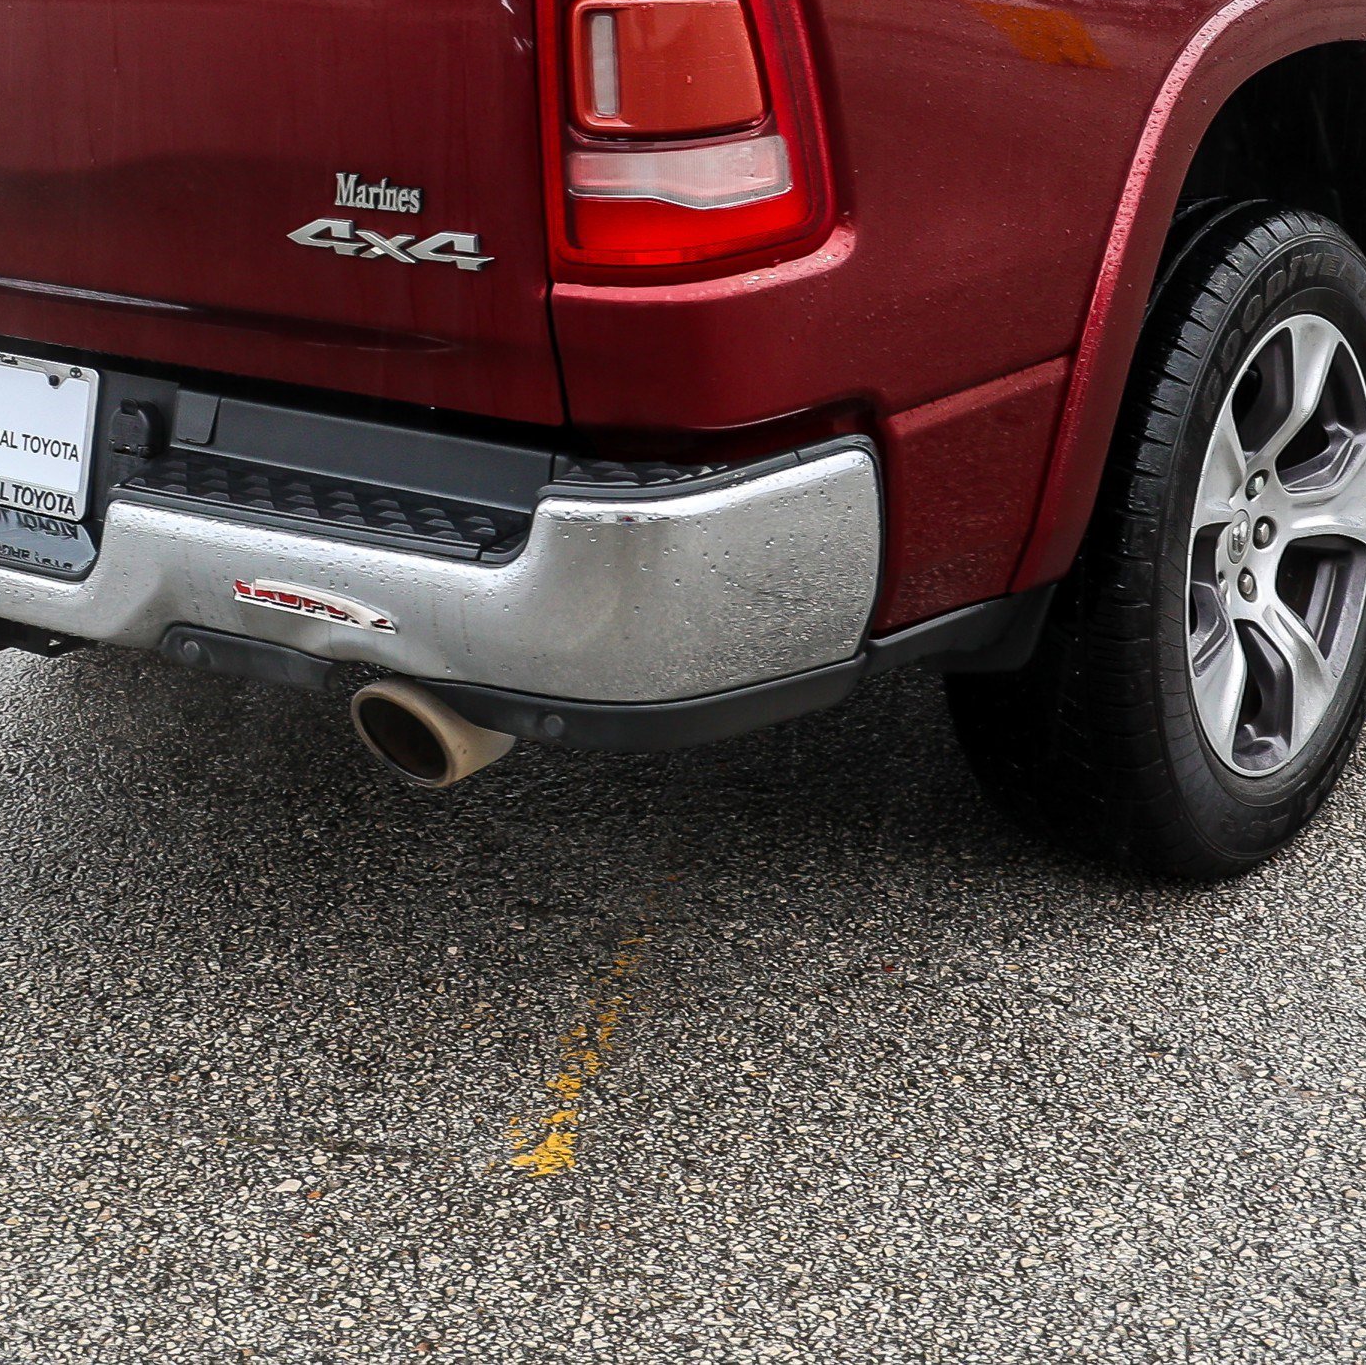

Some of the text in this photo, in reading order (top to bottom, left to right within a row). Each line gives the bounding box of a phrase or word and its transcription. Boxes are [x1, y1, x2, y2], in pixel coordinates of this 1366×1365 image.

[335, 172, 422, 214] Marines
[22, 434, 80, 463] TOYOTA
[12, 484, 76, 516] TOYOTA
